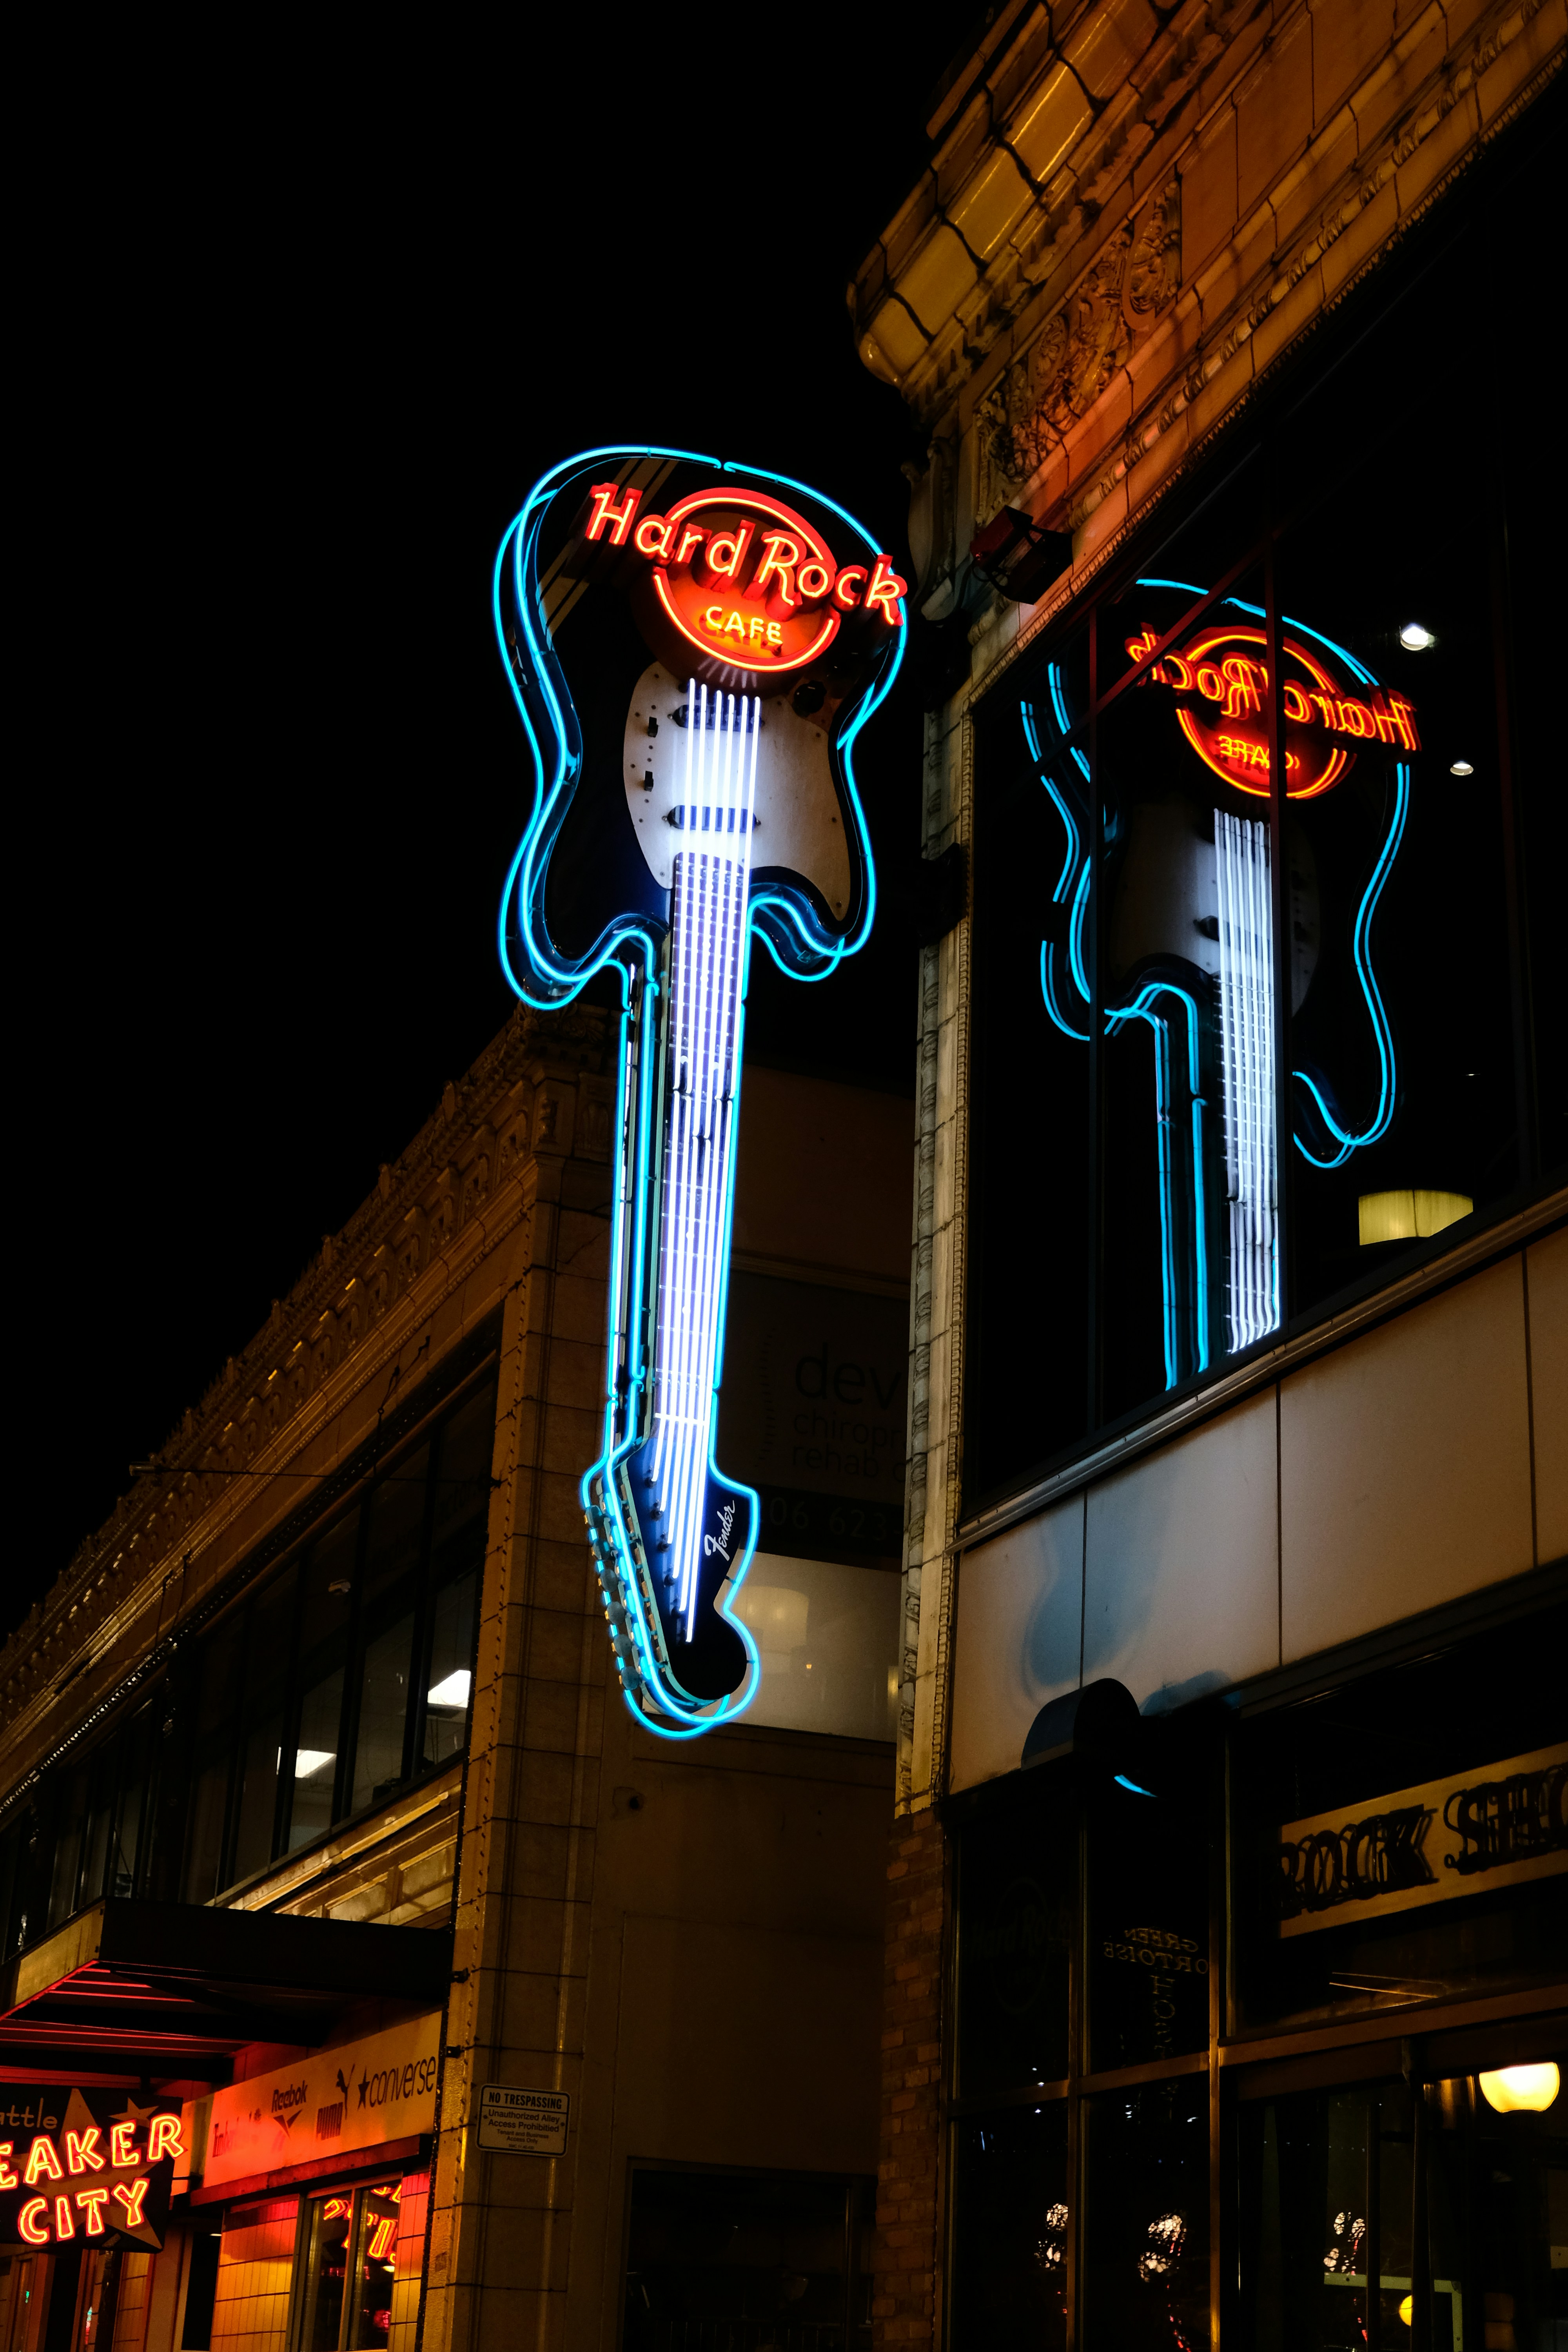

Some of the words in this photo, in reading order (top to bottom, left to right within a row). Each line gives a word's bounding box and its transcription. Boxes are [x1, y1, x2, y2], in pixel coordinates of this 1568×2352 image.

[585, 483, 757, 584] Hard
[744, 554, 907, 627] Rock
[704, 606, 783, 650] CAFE
[795, 1342, 901, 1410] dev
[793, 1408, 907, 1454] chiropr
[792, 1443, 879, 1478] rehab
[704, 1500, 735, 1562] Fender
[271, 2080, 308, 2113] Reebok
[370, 2056, 436, 2108] converse
[488, 2092, 501, 2103] NO
[504, 2093, 562, 2110] TRESPASSING
[316, 2102, 343, 2141] PUMA
[488, 2109, 539, 2121] Unauthorized
[541, 2114, 560, 2125] Alley
[488, 2119, 516, 2129] Access
[17, 2177, 151, 2245] CITY
